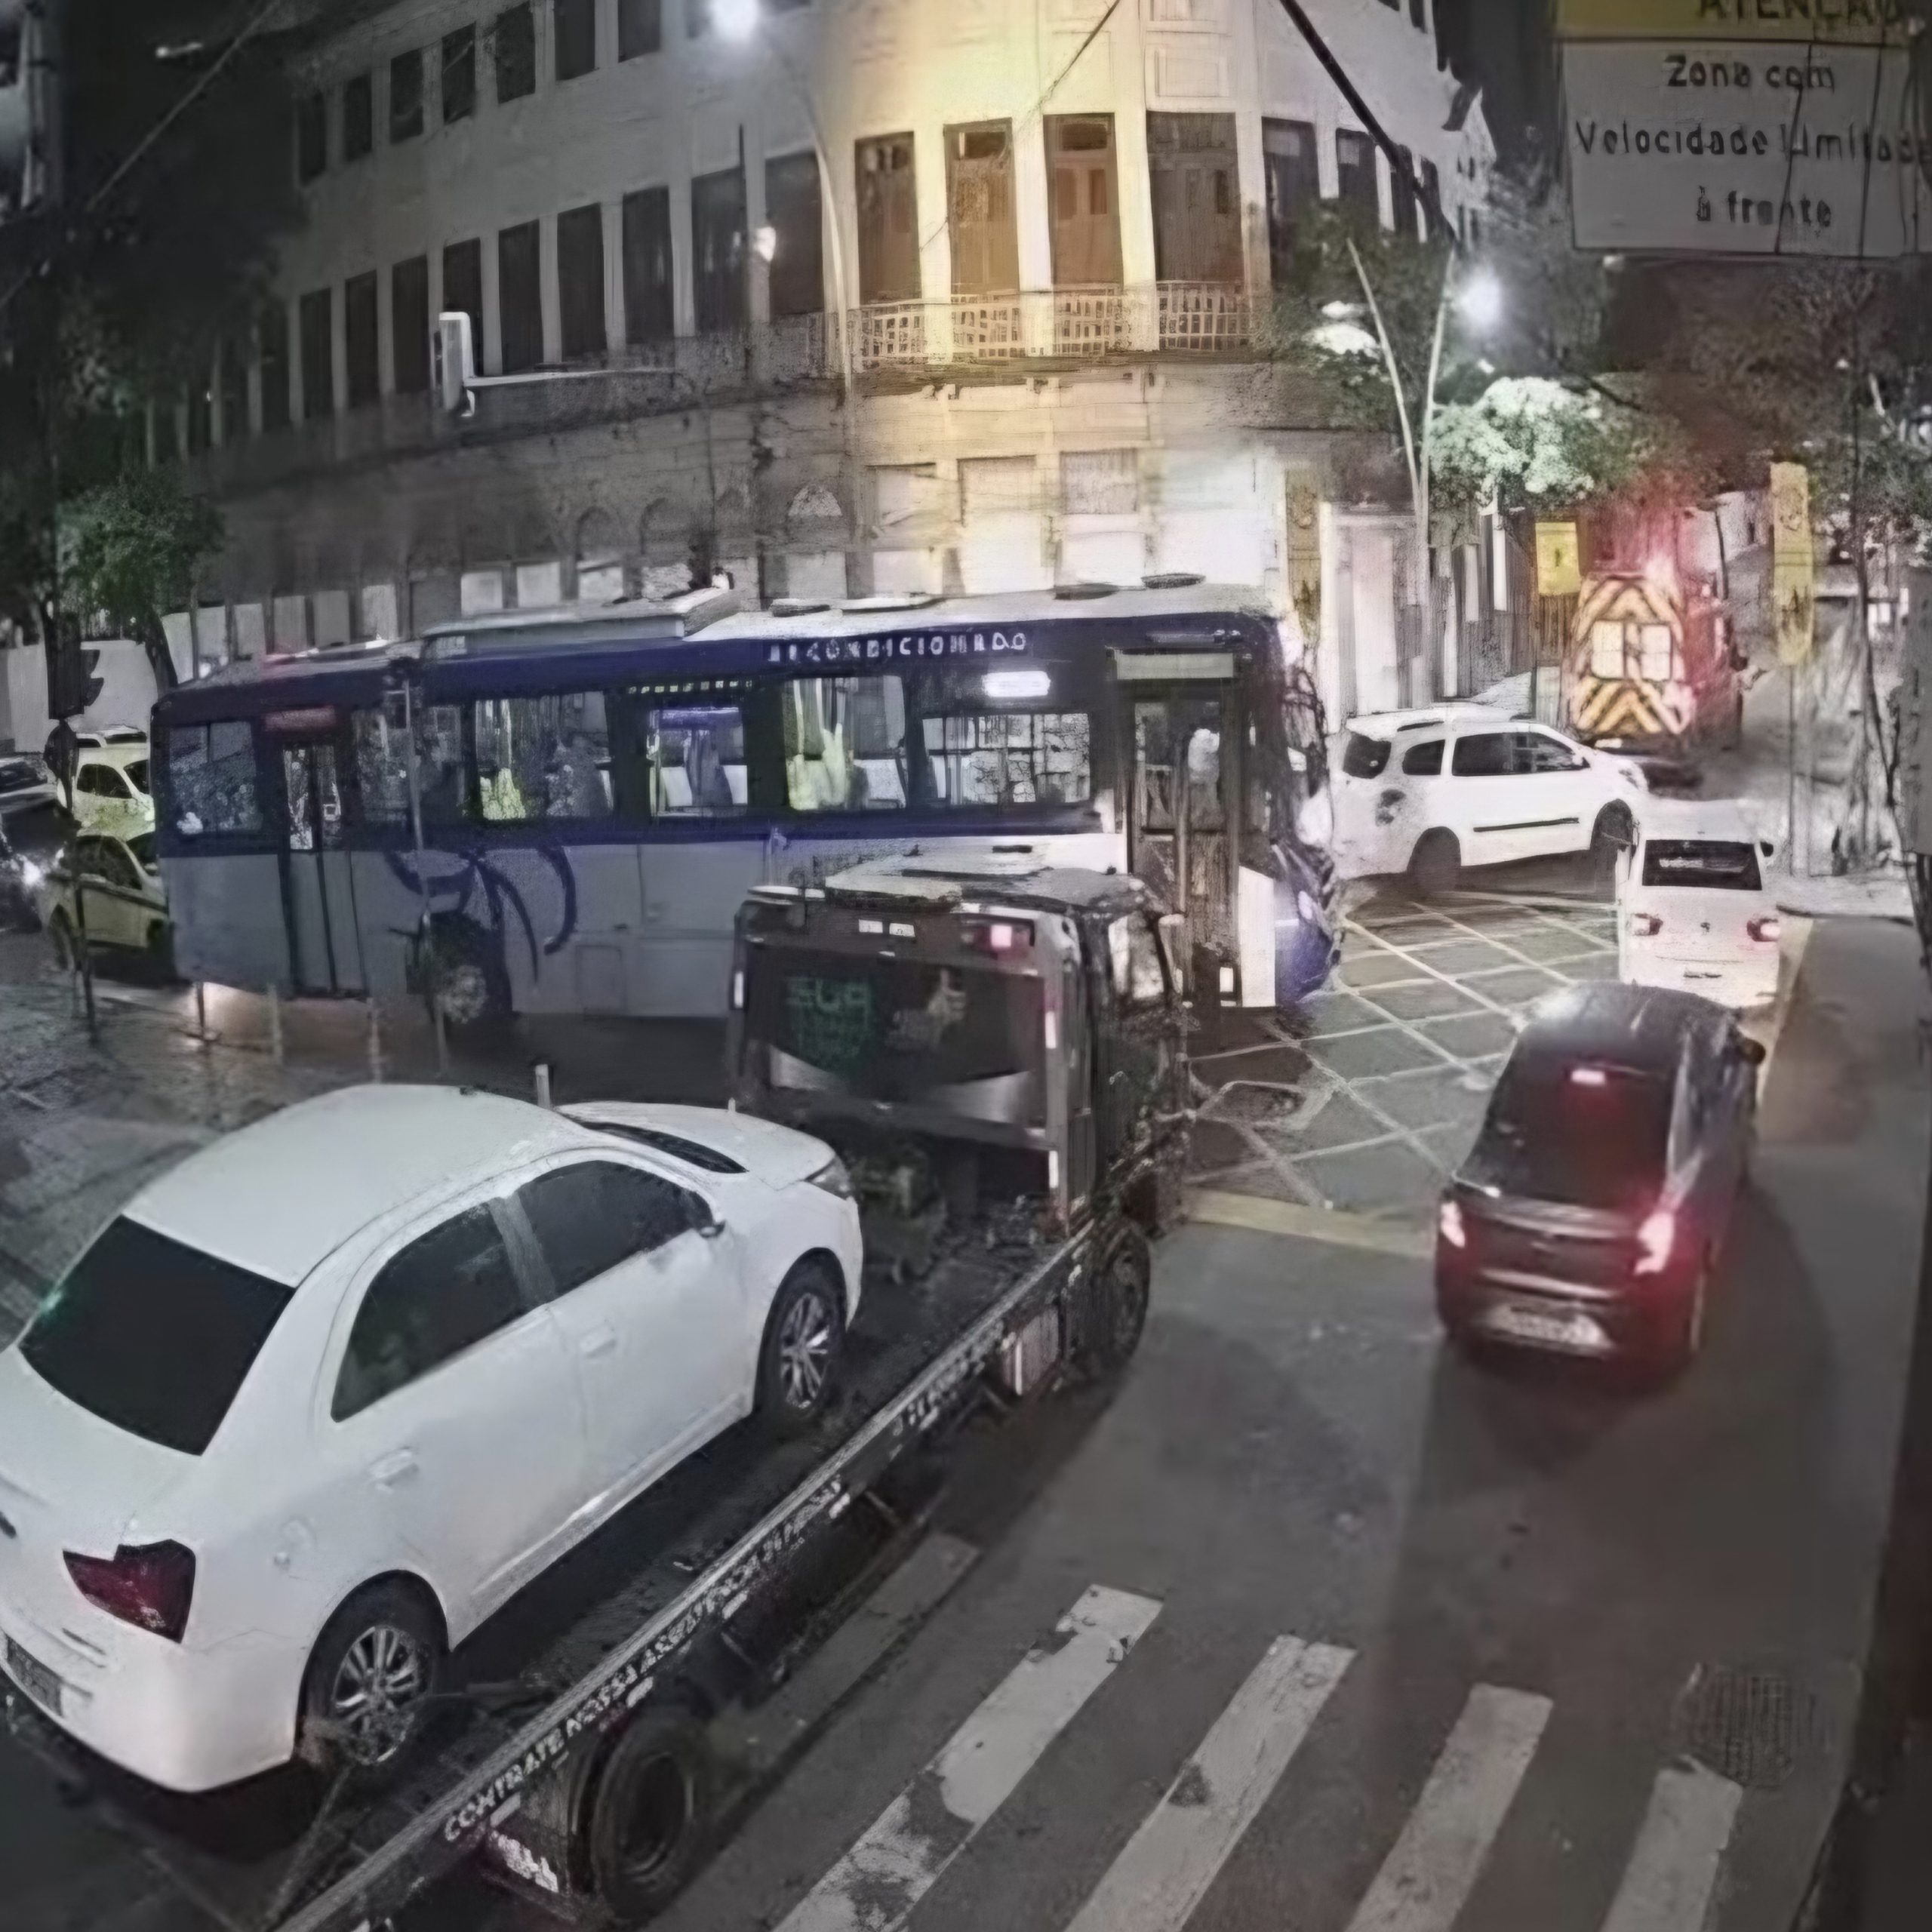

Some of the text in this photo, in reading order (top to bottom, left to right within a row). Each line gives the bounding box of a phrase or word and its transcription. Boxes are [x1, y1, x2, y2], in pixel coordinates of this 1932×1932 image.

[1666, 54, 1835, 90] Zona com
[1576, 121, 1768, 155] Velocidade
